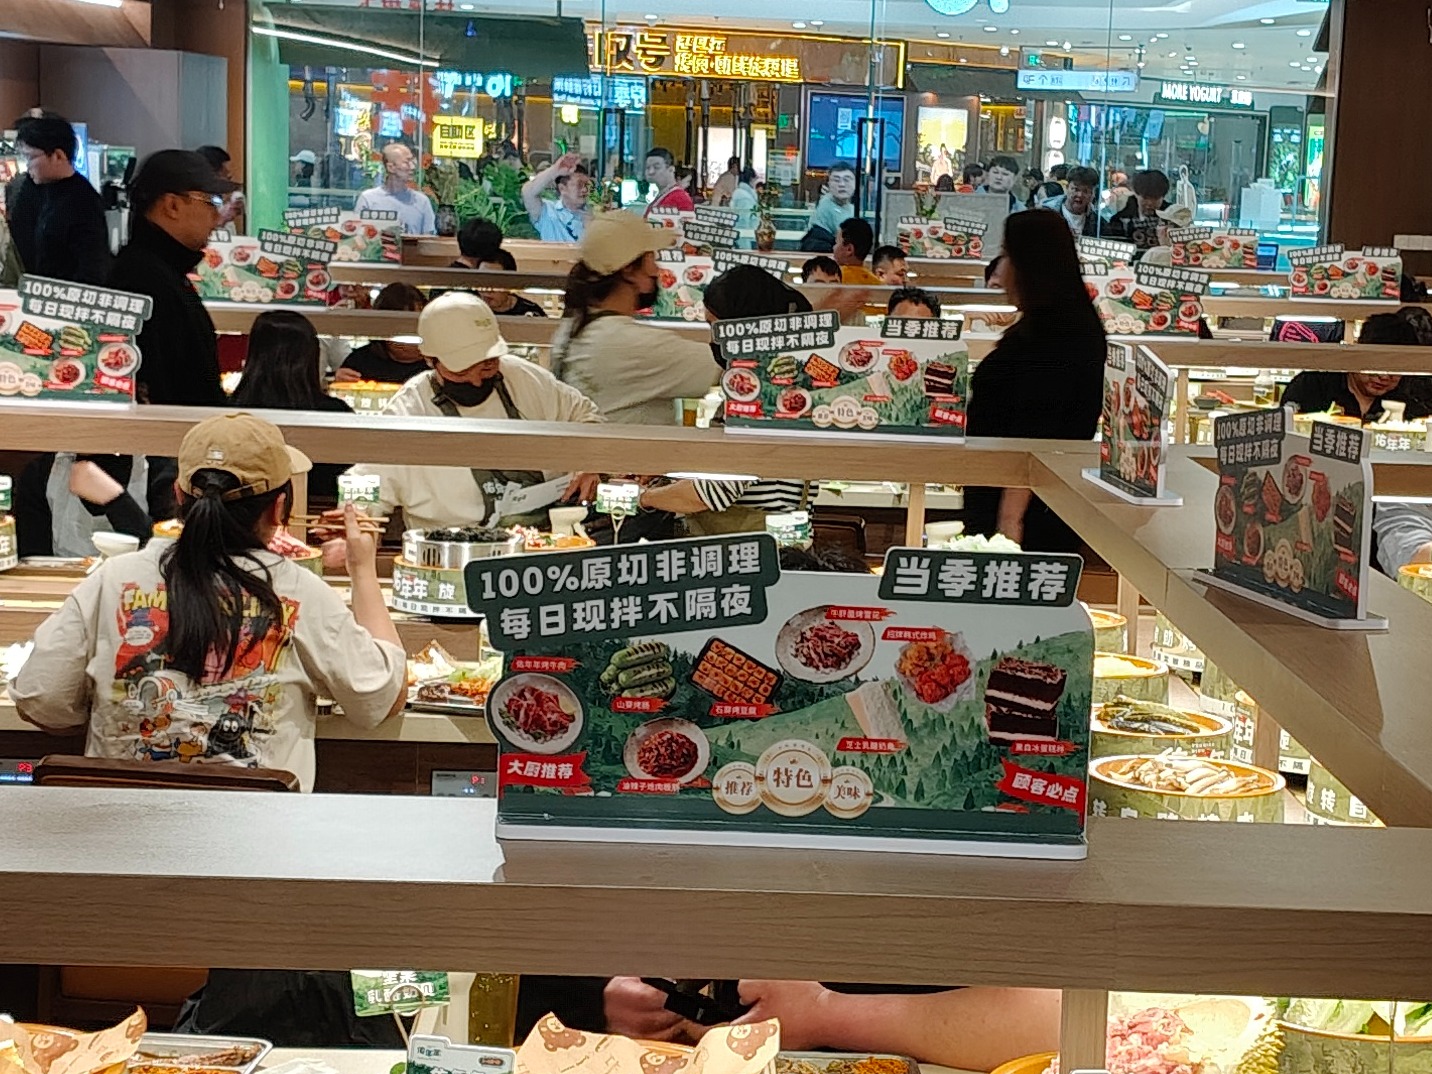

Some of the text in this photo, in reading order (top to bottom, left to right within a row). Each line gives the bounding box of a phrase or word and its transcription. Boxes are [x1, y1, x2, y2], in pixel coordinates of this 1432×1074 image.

[718, 313, 833, 339] 100%原切非调理
[885, 319, 959, 339] 当季推荐
[726, 330, 830, 355] 每日现拌不隔夜
[480, 541, 761, 600] 100%原切非调理
[893, 556, 1070, 601] 当季推荐
[500, 585, 753, 640] 每日现拌不隔夜
[507, 760, 574, 780] 大厨推荐
[772, 767, 814, 789] 特色
[834, 785, 861, 800] 美味
[1012, 772, 1080, 804] 顾客必点
